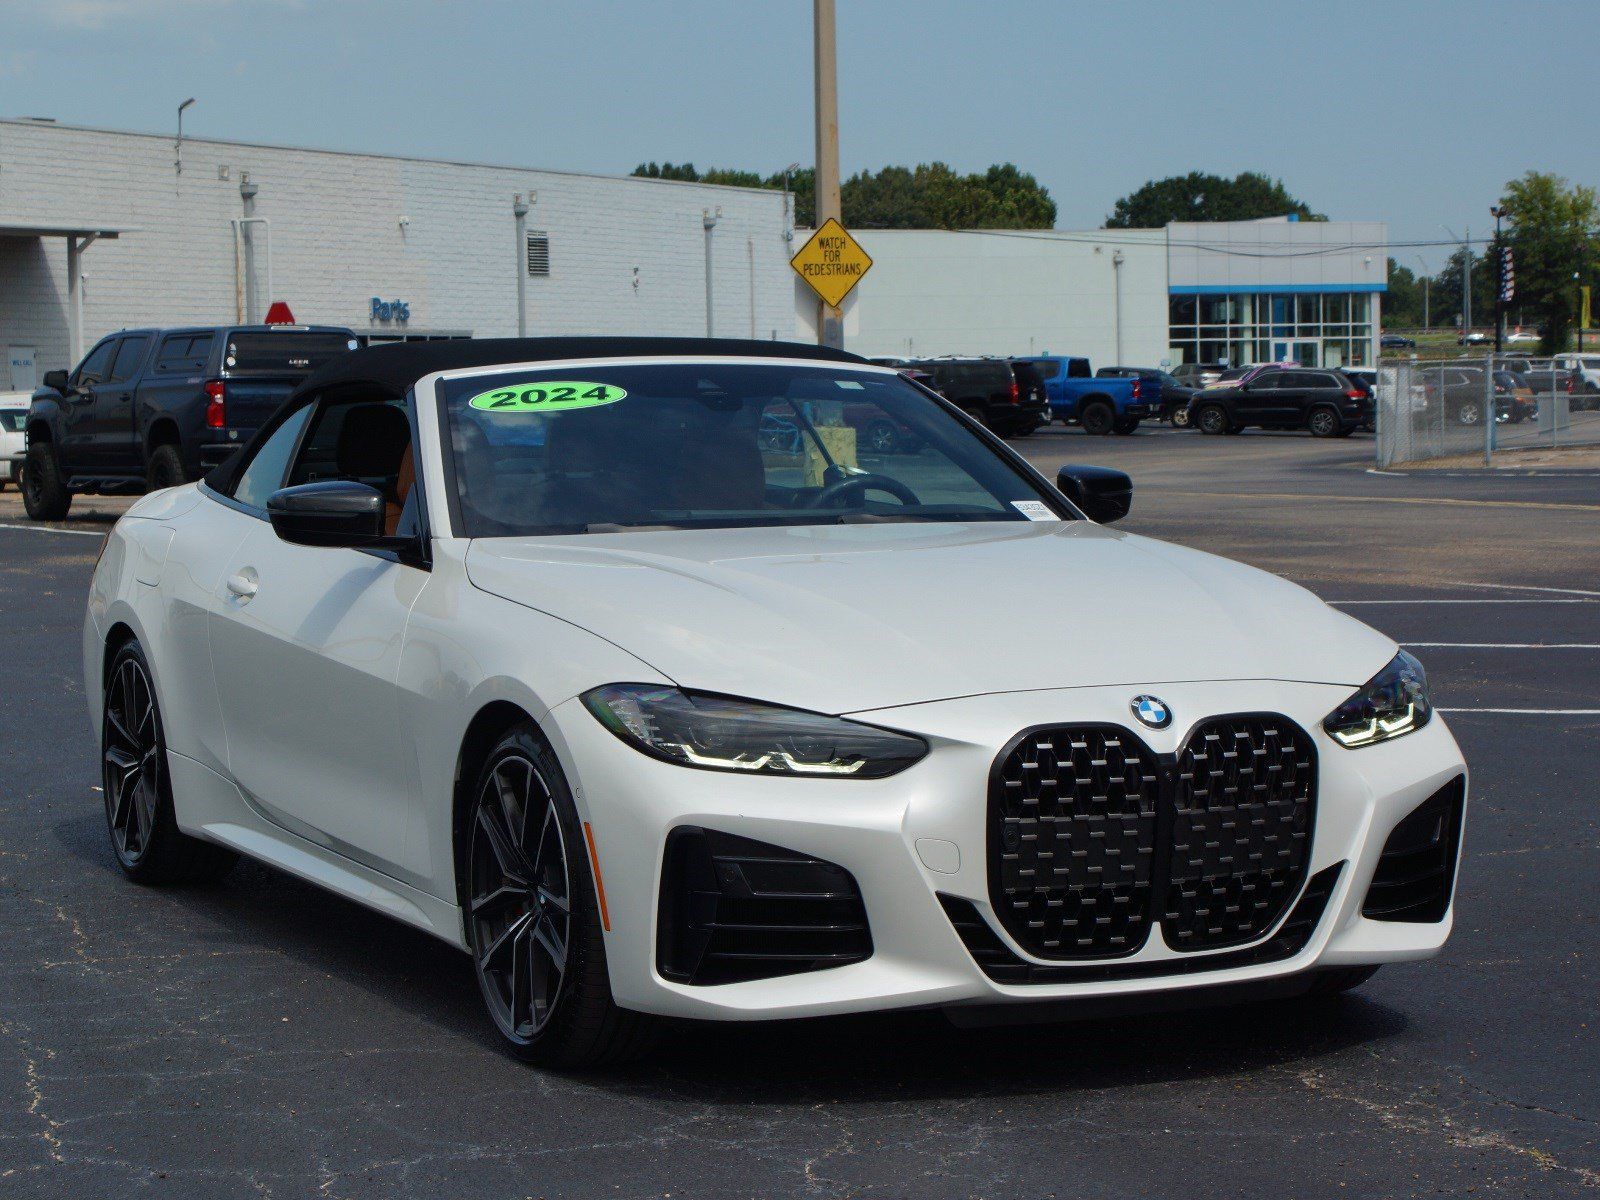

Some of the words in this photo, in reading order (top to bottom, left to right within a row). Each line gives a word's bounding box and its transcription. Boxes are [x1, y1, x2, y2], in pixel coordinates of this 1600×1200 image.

[818, 237, 846, 250] WATCH
[824, 250, 841, 262] FOR
[803, 263, 862, 276] PEDESTRIANS
[369, 296, 410, 321] Parts
[489, 386, 610, 408] 2024
